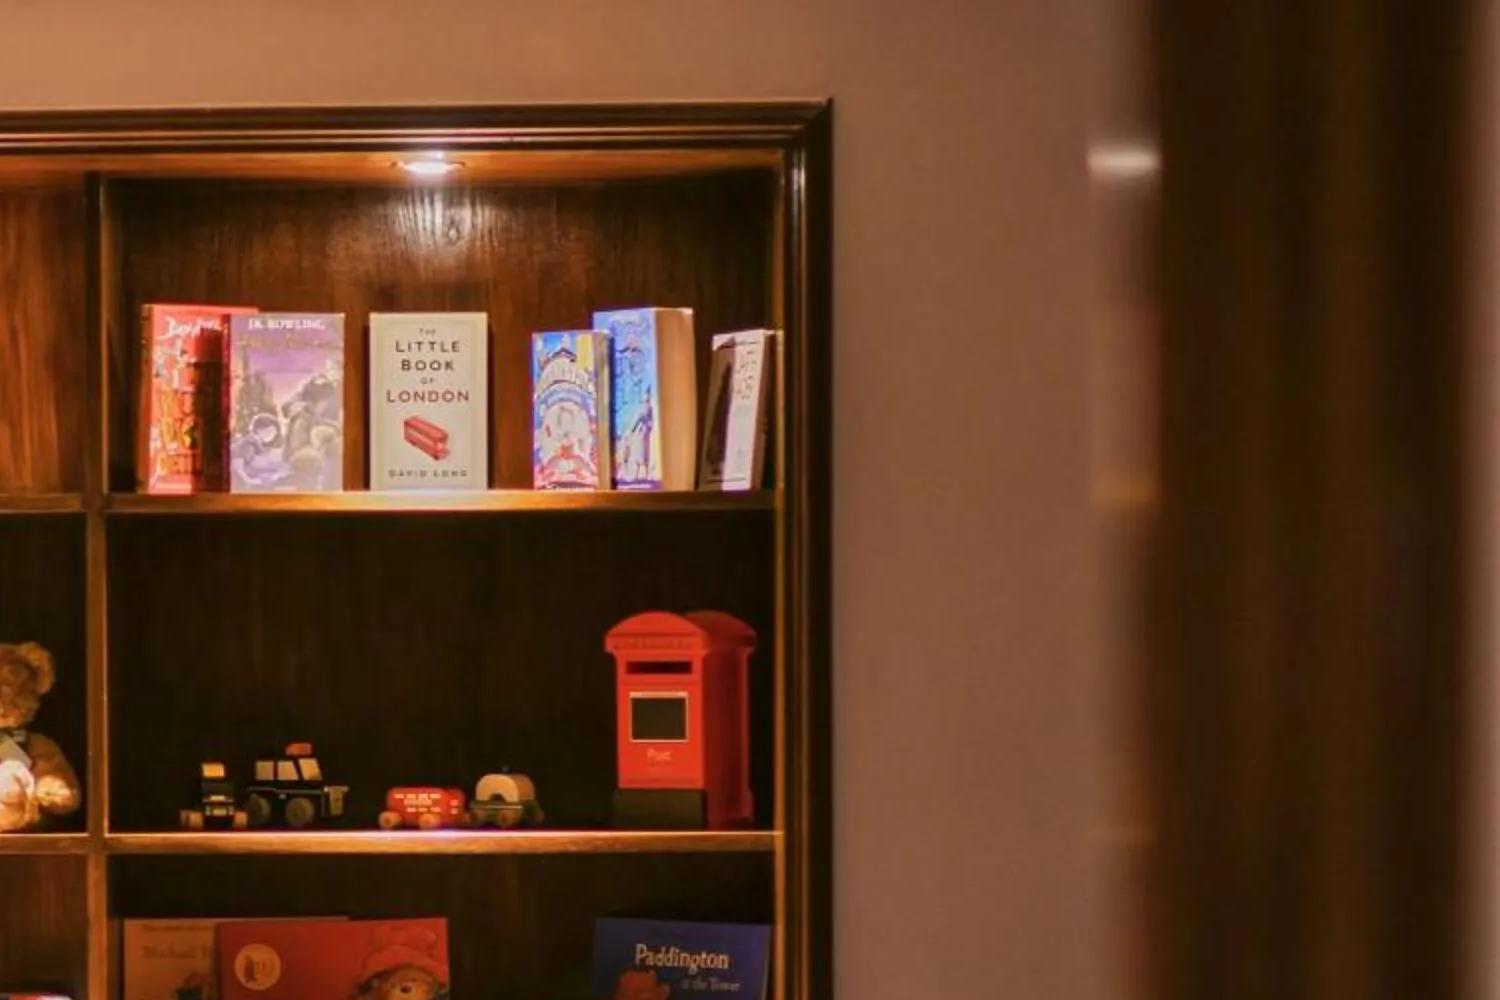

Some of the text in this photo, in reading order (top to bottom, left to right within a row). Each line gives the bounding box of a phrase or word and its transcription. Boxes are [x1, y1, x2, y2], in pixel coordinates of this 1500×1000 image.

[267, 318, 327, 331] ROWLING
[395, 340, 461, 353] LITTLE
[400, 359, 454, 371] BOOK
[420, 376, 435, 385] OF
[386, 389, 470, 403] LONDON
[635, 943, 730, 974] Paddington
